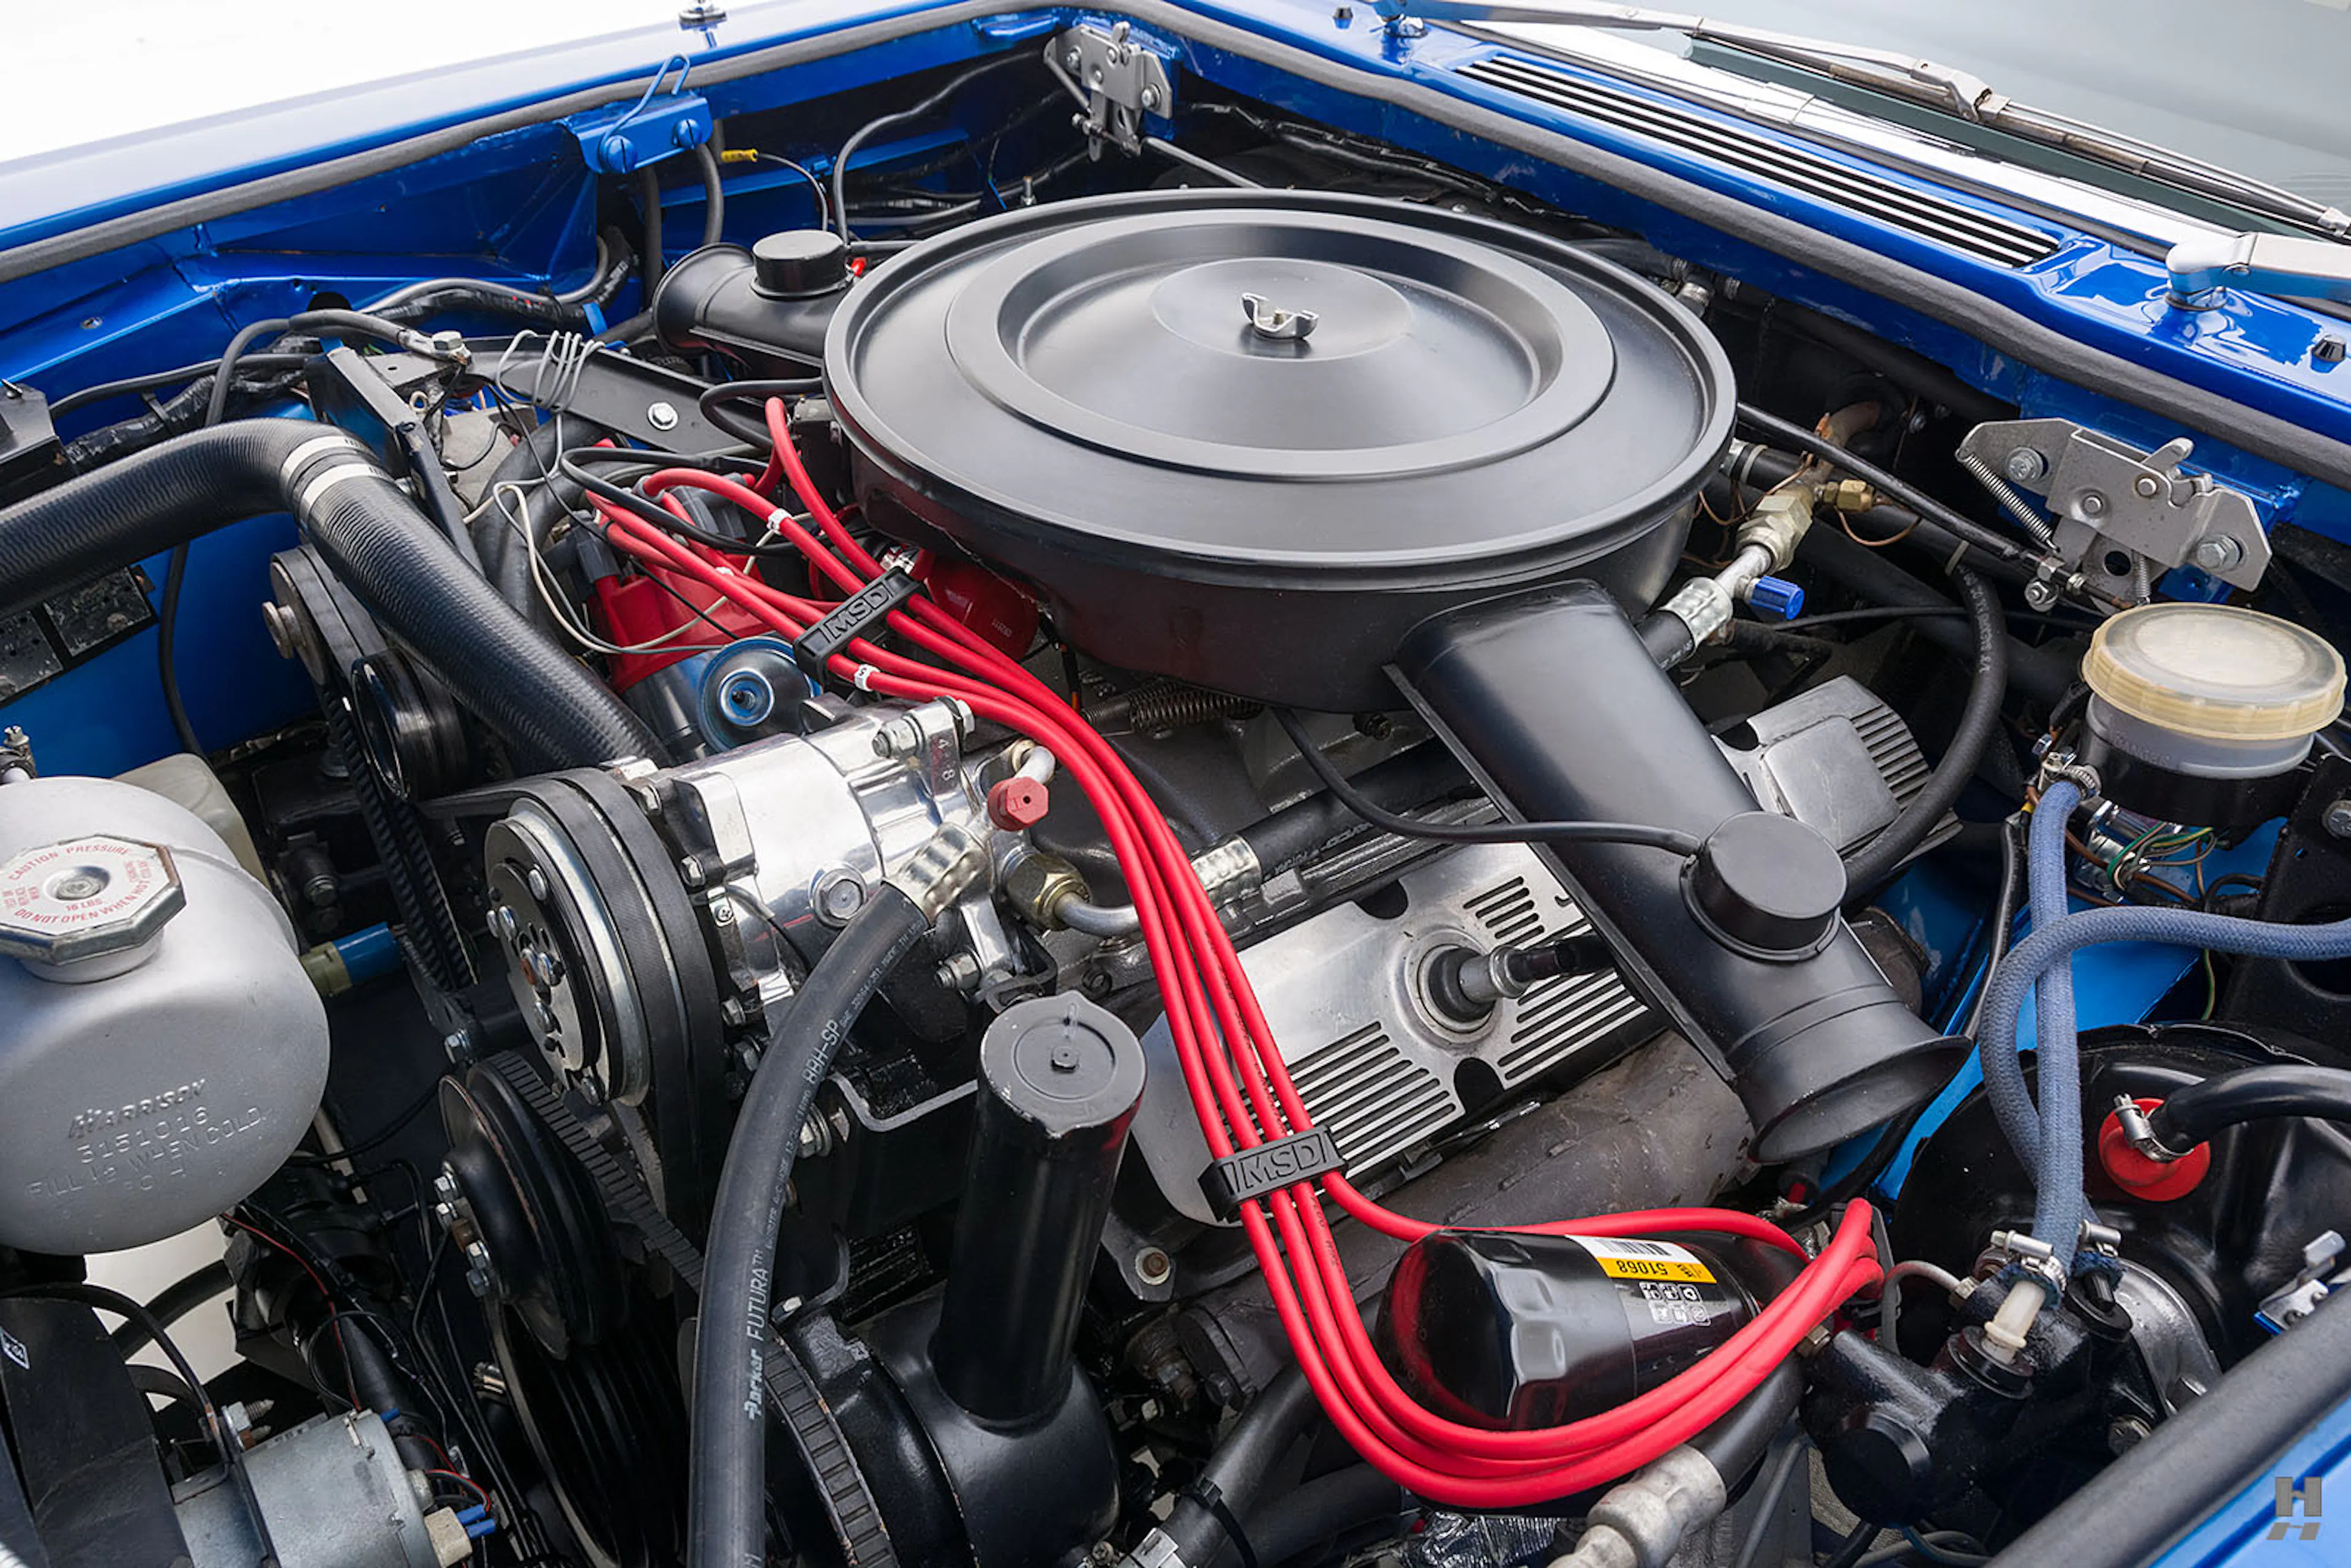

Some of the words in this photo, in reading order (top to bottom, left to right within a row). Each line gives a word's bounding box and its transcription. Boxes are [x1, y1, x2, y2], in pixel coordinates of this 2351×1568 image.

[824, 583, 890, 639] MSD
[9, 852, 59, 881] CAUTION
[66, 844, 130, 856] PRESSURE
[15, 909, 32, 920] DO
[34, 912, 60, 924] NOT
[61, 911, 99, 923] OPEN
[99, 896, 137, 915] WHEN
[69, 1079, 206, 1139] HARRISON
[26, 1174, 84, 1199] FILL
[129, 1133, 200, 1172] WHEN
[1239, 1135, 1321, 1188] MSD
[1616, 1259, 1668, 1276] 51068
[744, 1349, 763, 1420] Parker
